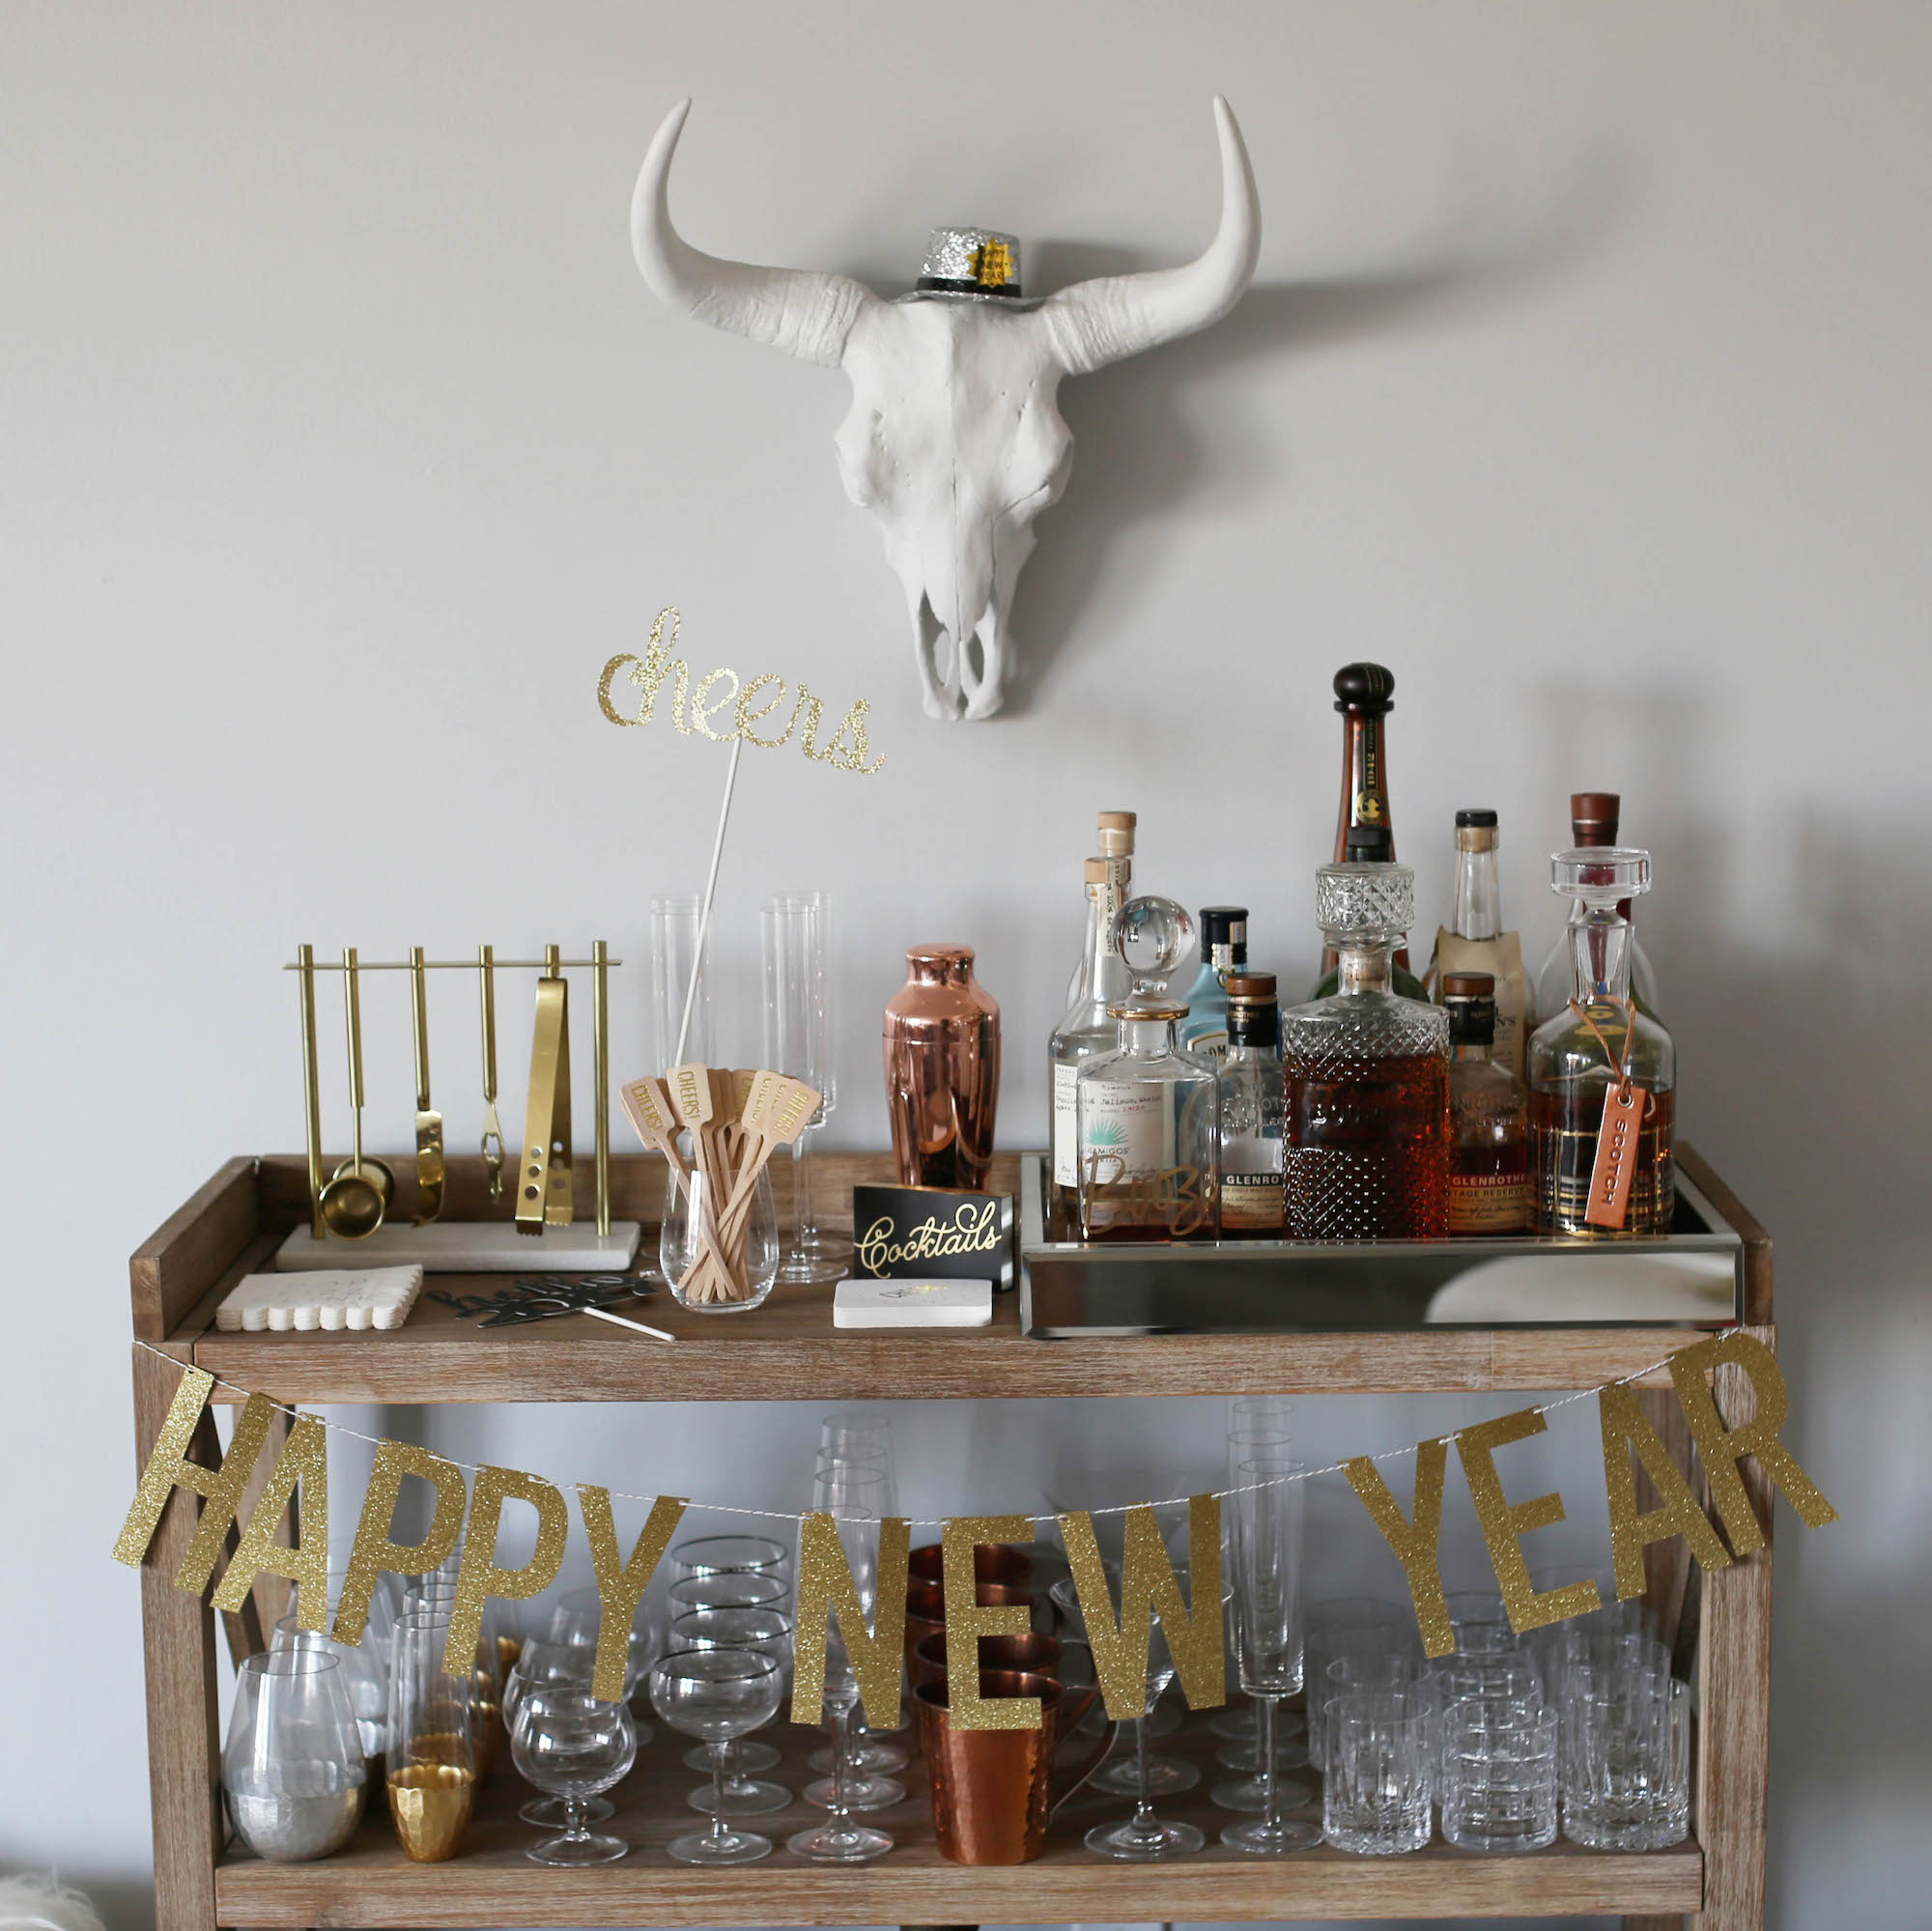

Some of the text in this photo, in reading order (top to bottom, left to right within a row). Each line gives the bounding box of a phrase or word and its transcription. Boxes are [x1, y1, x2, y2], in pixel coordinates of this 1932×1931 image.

[597, 605, 887, 774] cheers
[631, 1083, 667, 1133] CHEERS!
[676, 1069, 702, 1121] CHEERS!
[773, 1089, 810, 1137] CHEERS!
[1226, 1174, 1281, 1185] GLENRO
[1601, 1119, 1630, 1207] SCOTCH
[1452, 1189, 1480, 1199] TAGE
[854, 1201, 1003, 1280] Cocktails
[111, 1332, 1839, 1731] HAPPY NEW YEAR
